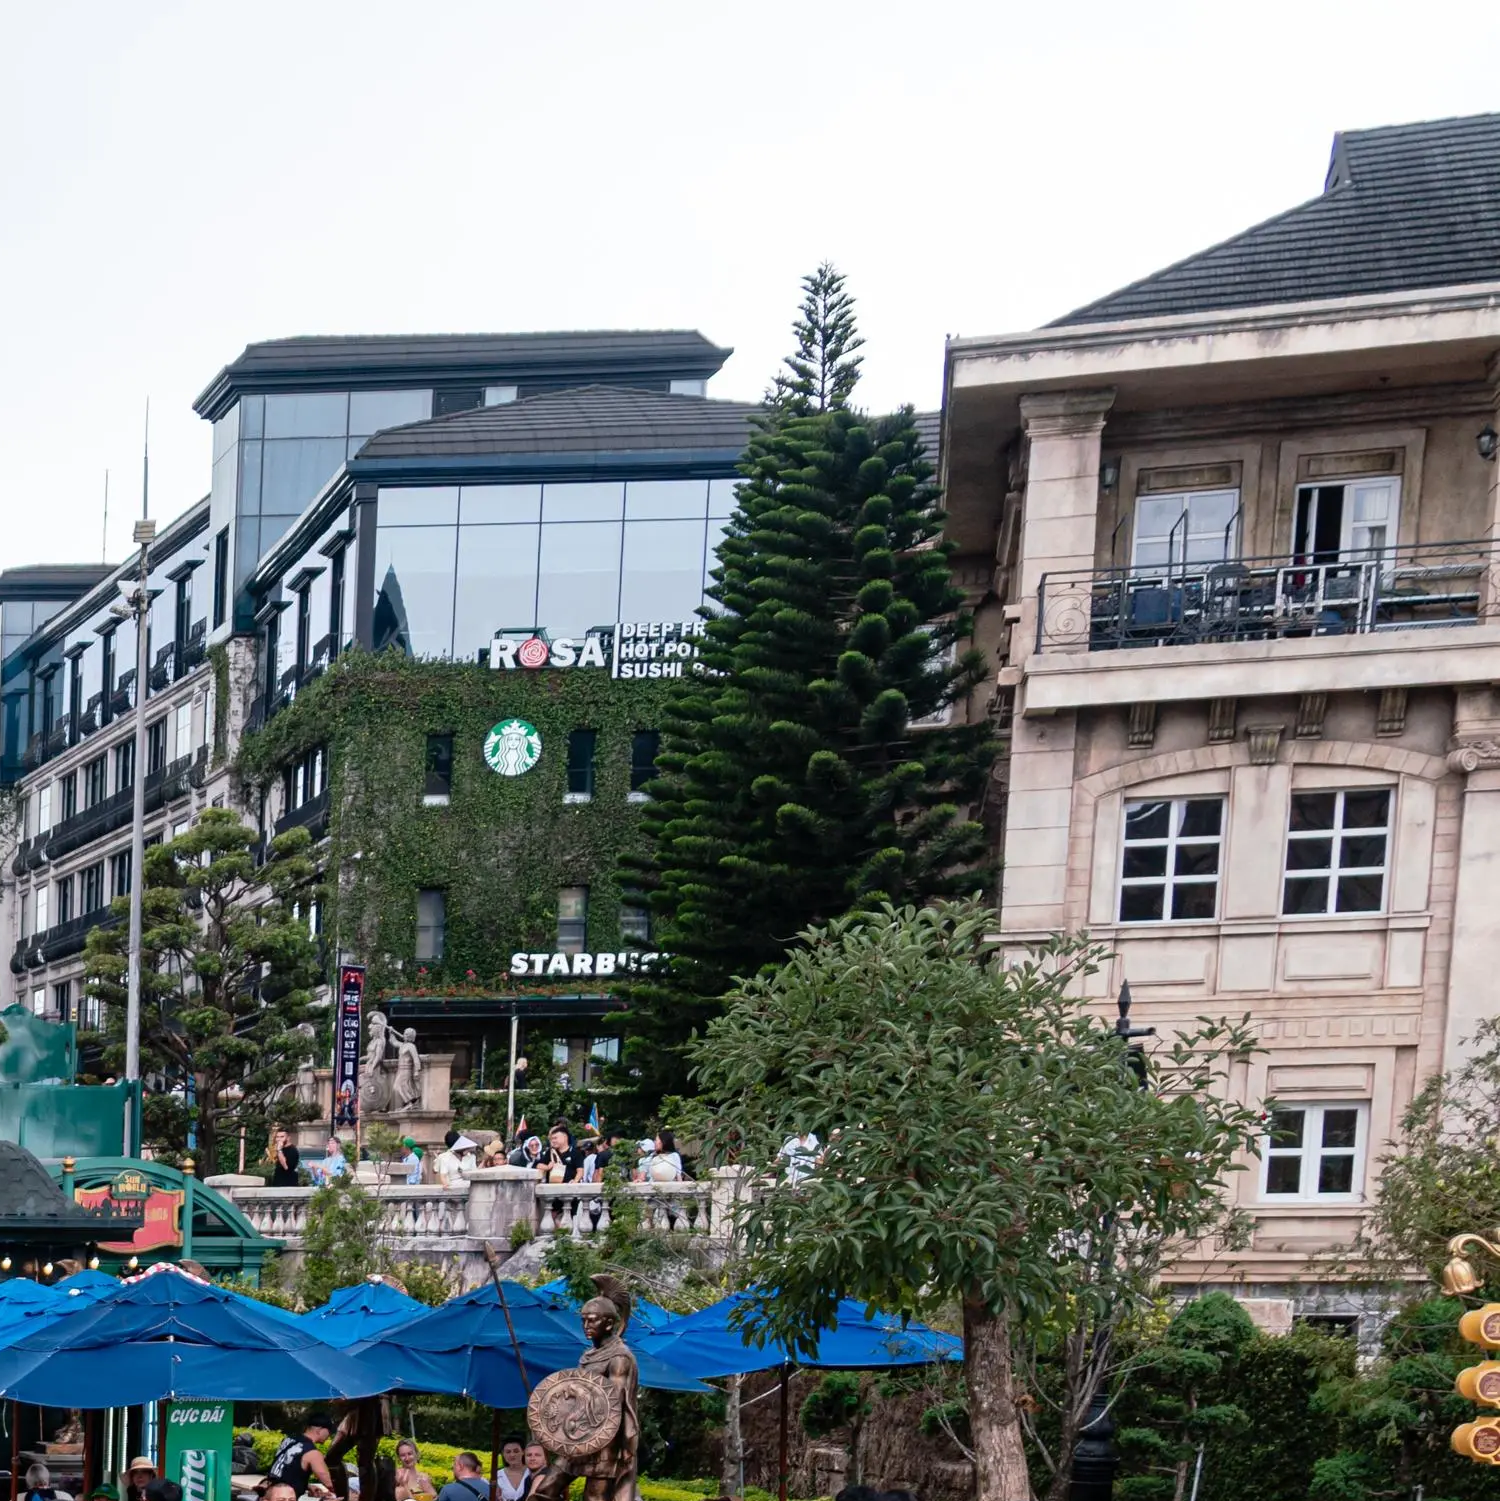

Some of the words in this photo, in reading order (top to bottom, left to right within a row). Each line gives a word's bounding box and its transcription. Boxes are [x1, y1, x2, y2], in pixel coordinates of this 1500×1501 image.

[622, 622, 676, 638] DEEP
[681, 622, 706, 637] FR
[489, 637, 606, 669] ROSA
[620, 642, 660, 659] HOT
[619, 661, 682, 679] SUSHI
[170, 1408, 200, 1426] CỰC
